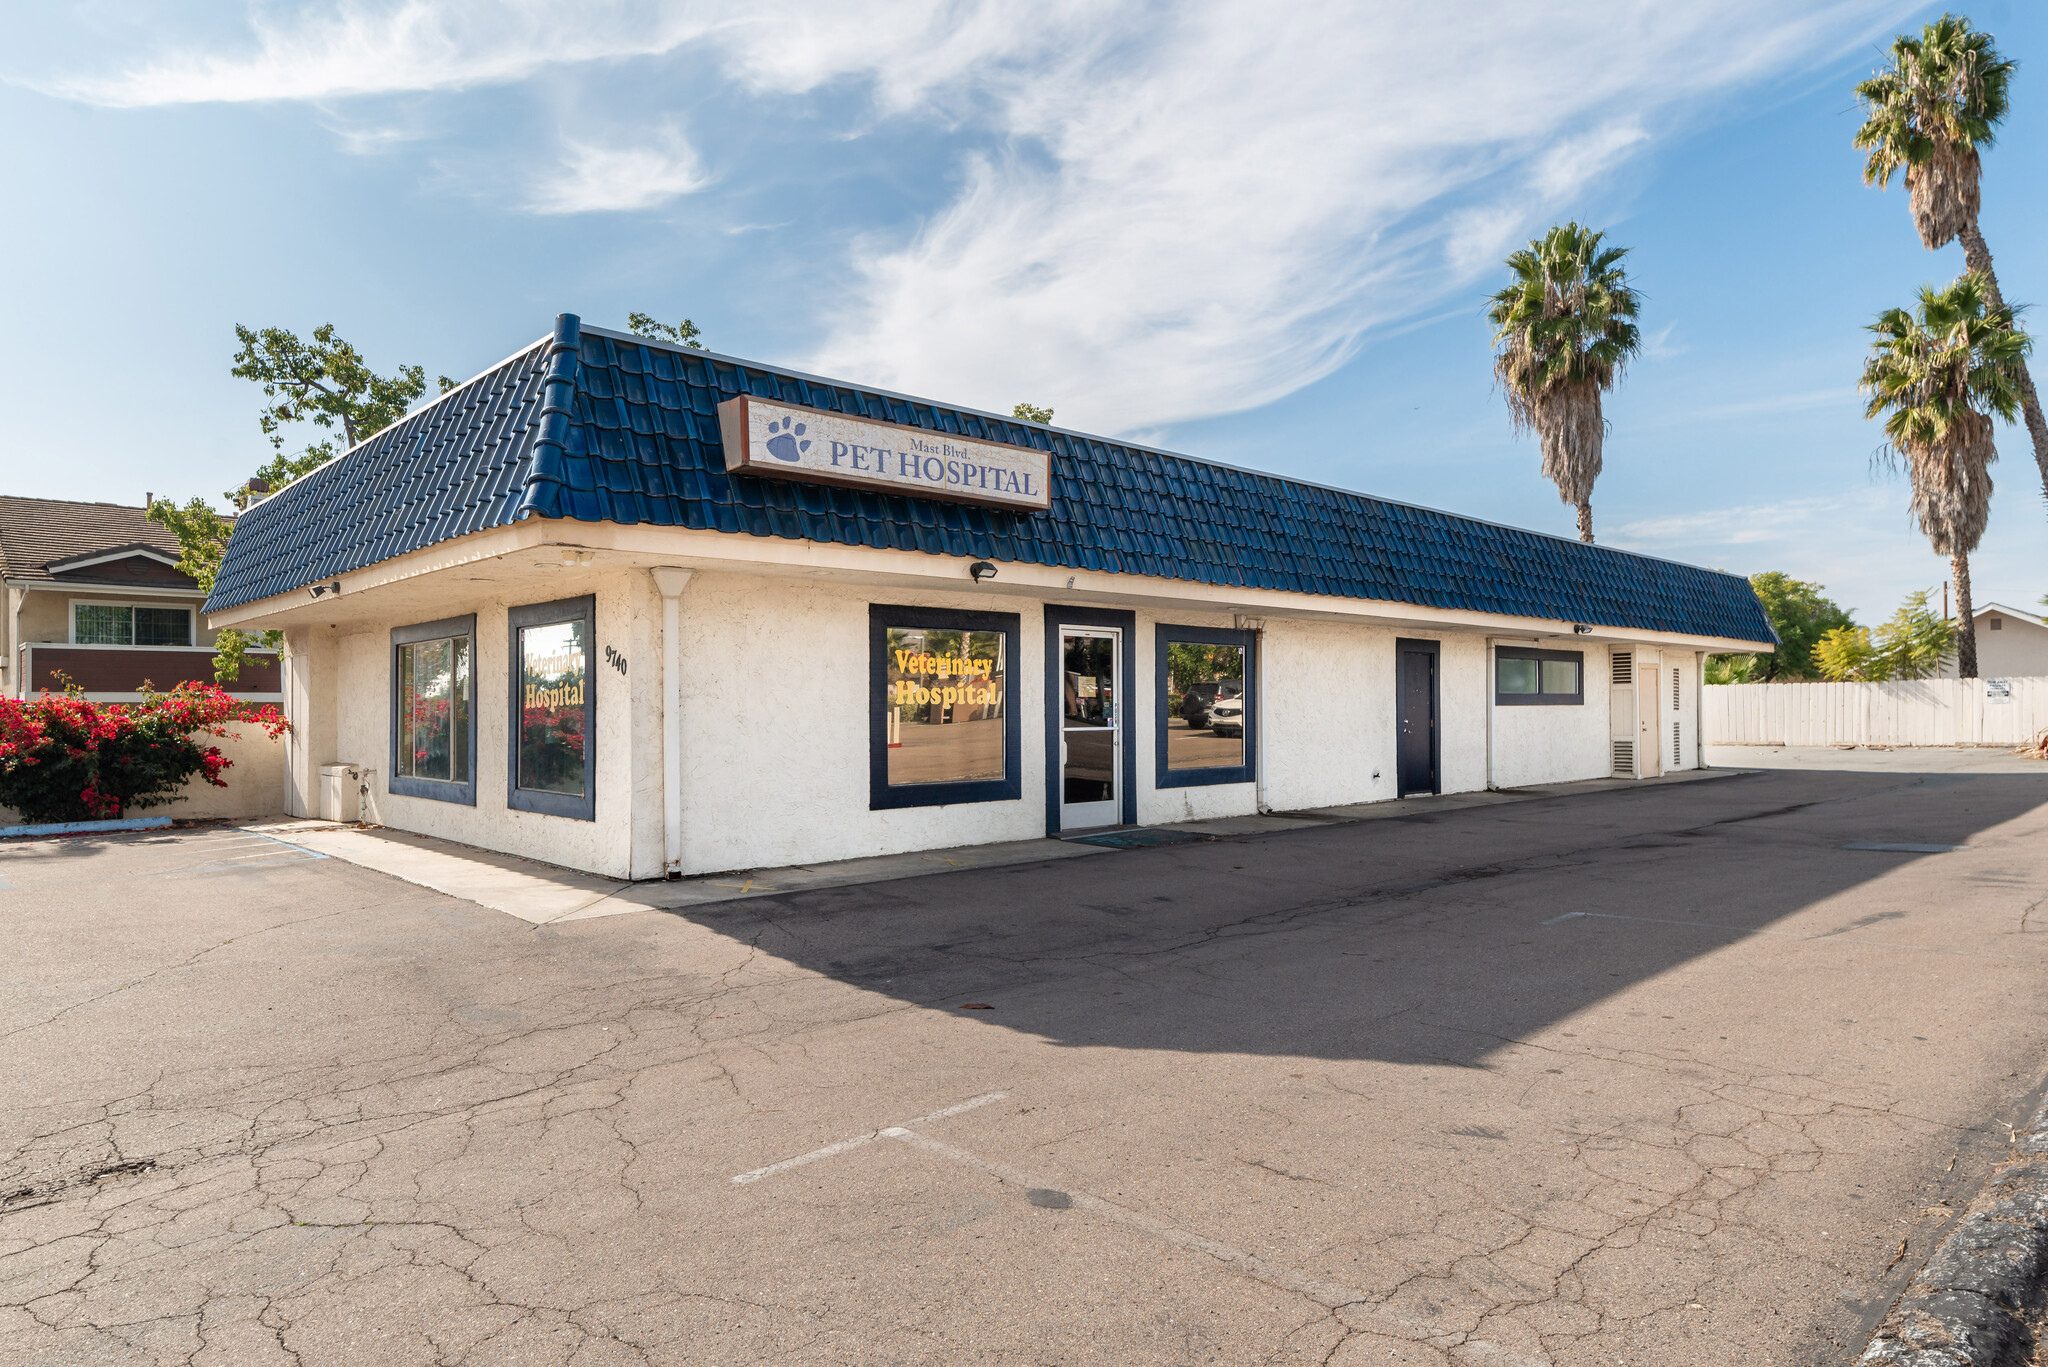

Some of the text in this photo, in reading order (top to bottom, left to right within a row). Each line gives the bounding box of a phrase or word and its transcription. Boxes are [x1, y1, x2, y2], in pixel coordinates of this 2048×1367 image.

[910, 438, 971, 460] Mast Blvd.
[829, 440, 1038, 497] PET HOSPITAL
[525, 649, 582, 677] Veterinary
[605, 644, 627, 676] 9740
[894, 649, 993, 681] Veterinary
[525, 678, 585, 712] Hospital
[895, 680, 998, 709] Hospital
